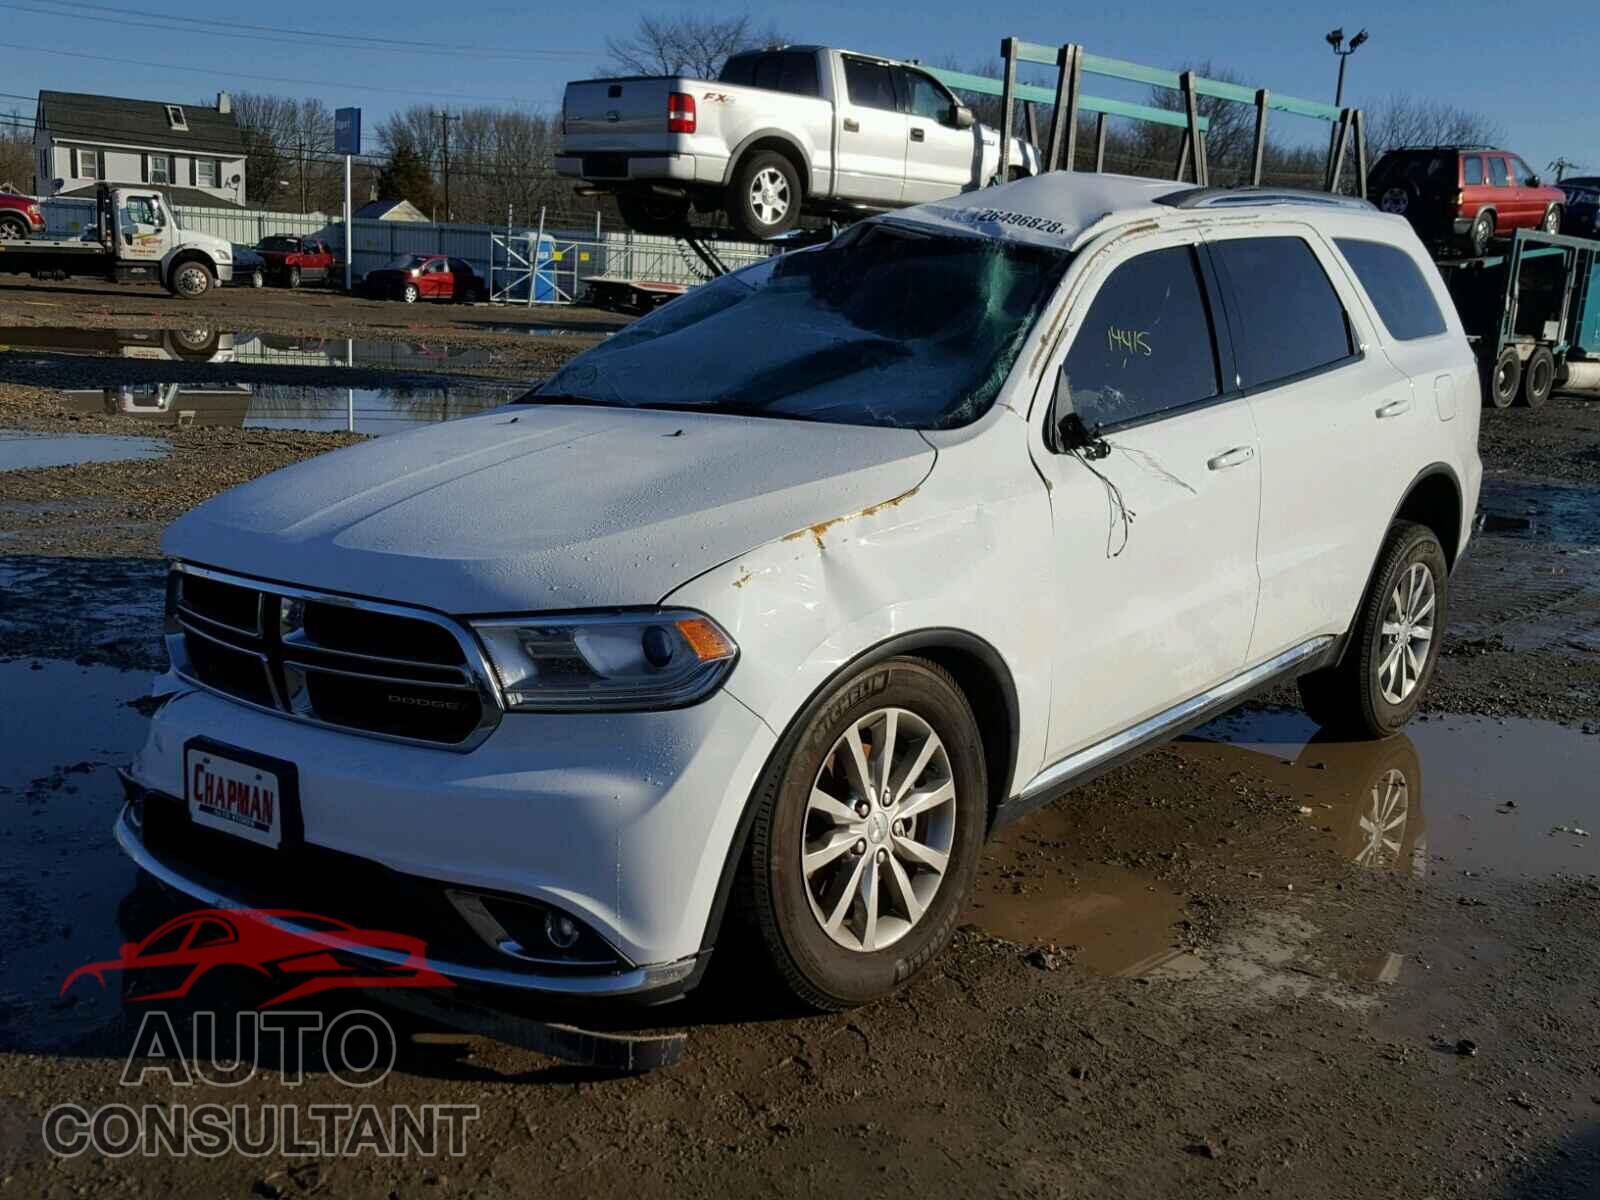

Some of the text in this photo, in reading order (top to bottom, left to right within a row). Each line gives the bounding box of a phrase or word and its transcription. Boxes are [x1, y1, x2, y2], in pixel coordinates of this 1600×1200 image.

[1103, 321, 1152, 356] 14415
[388, 693, 460, 711] DODGE
[193, 764, 273, 824] CHAPMAN
